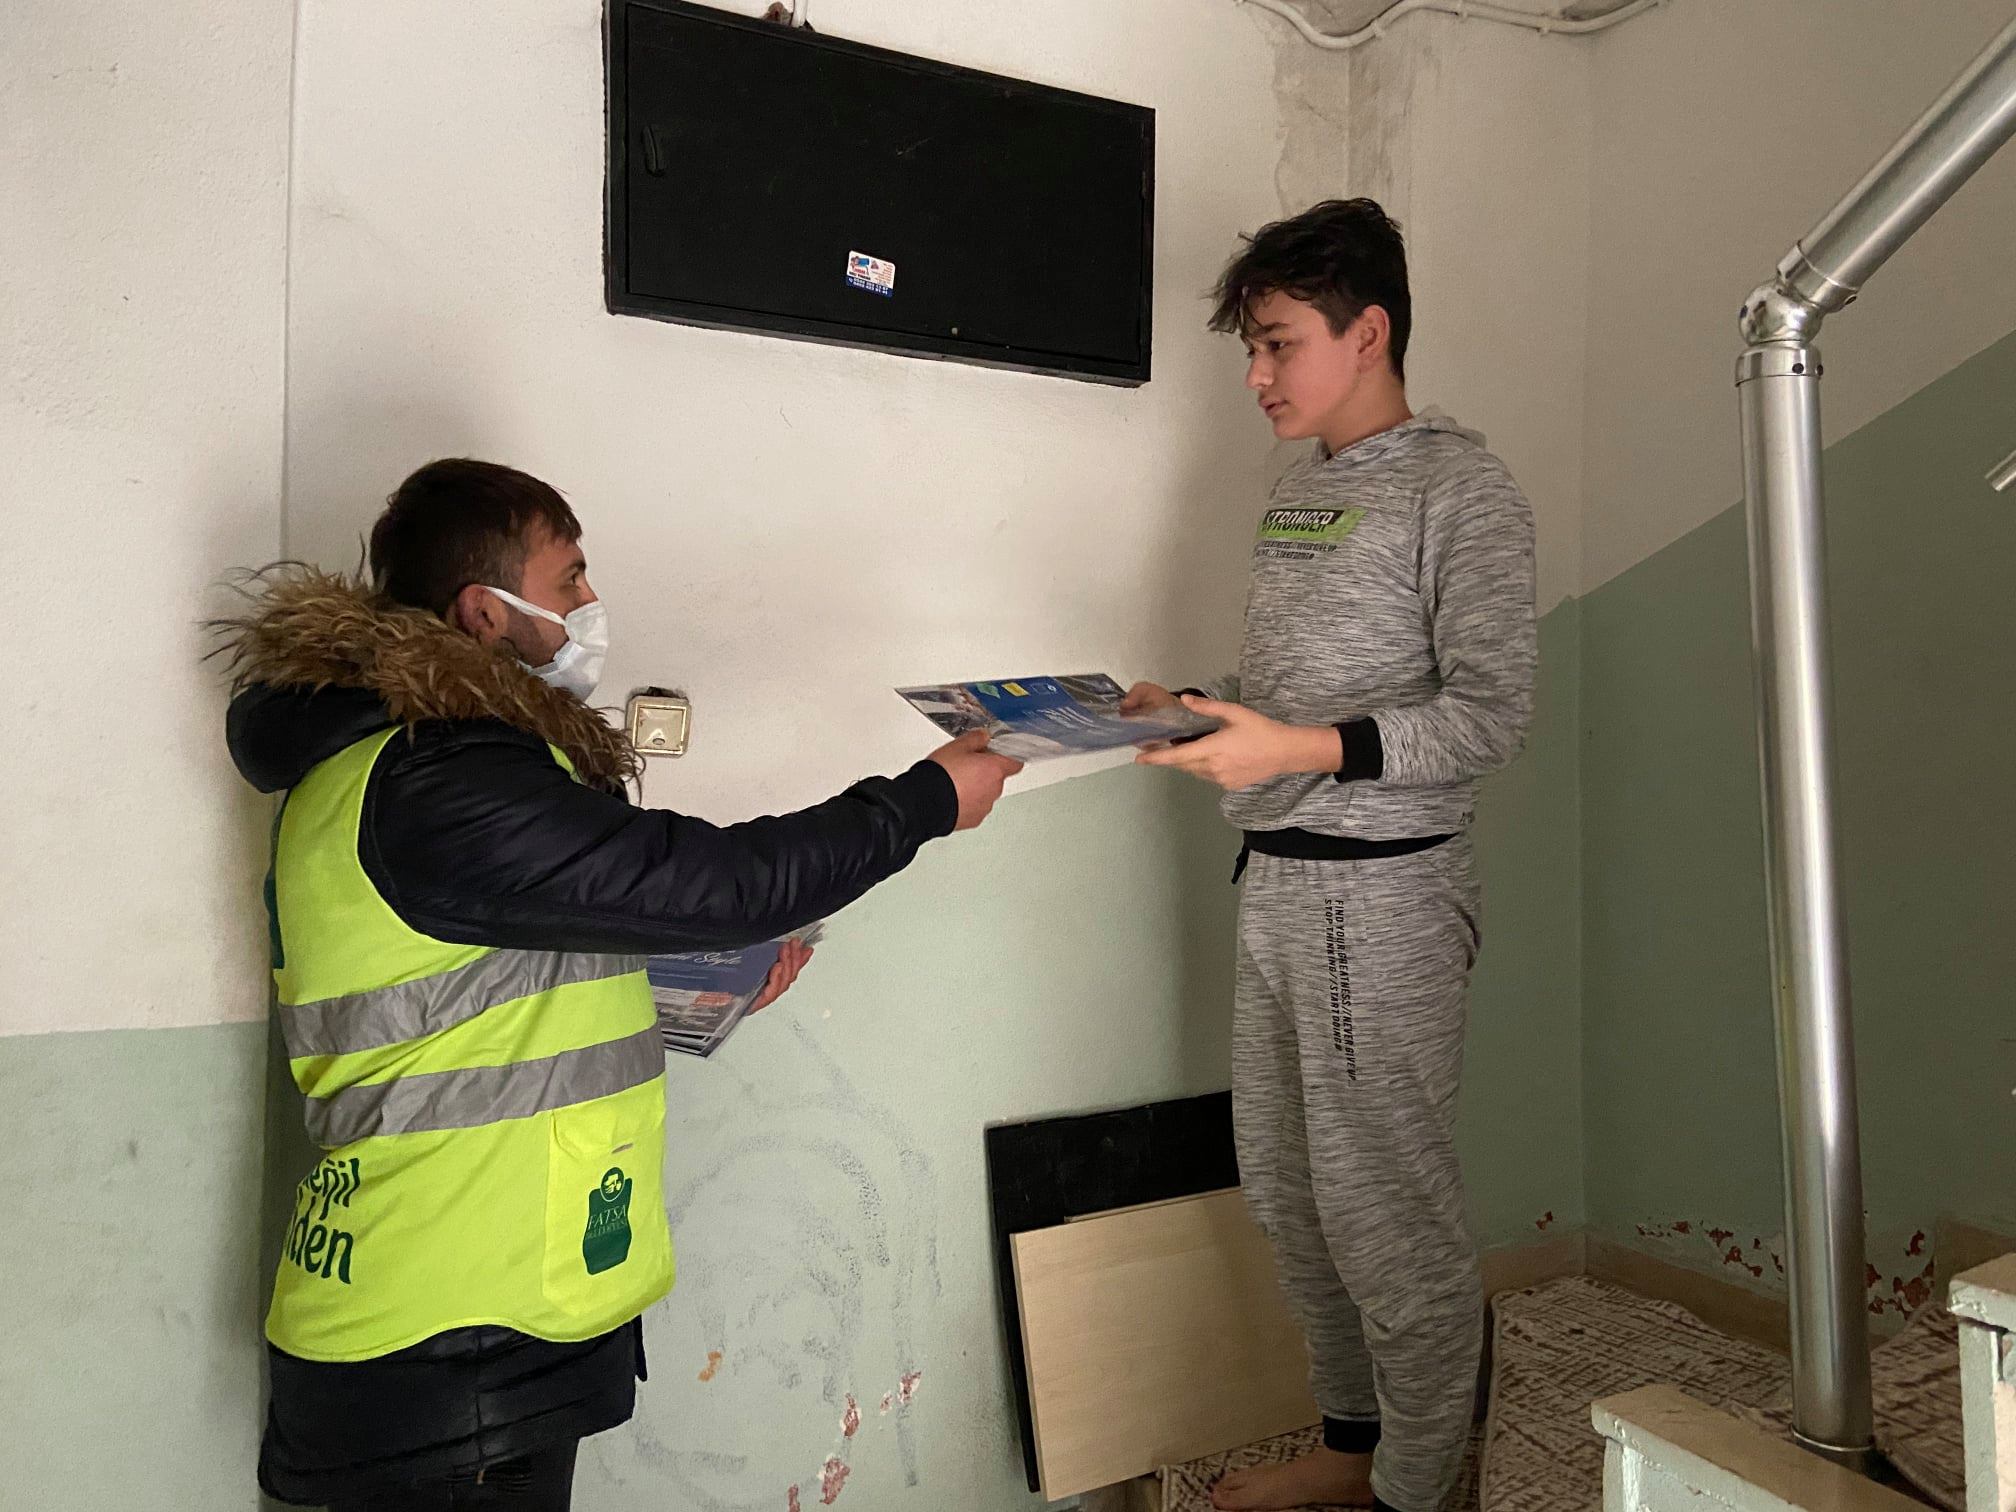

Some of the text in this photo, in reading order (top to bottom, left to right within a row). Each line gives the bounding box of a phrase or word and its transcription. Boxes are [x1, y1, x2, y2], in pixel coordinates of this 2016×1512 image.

[1325, 899, 1334, 924] STOP
[1335, 899, 1345, 922] FIND
[1336, 925, 1346, 950] YOUR
[1345, 1047, 1356, 1067] GIVE
[588, 1204, 627, 1230] FATSA
